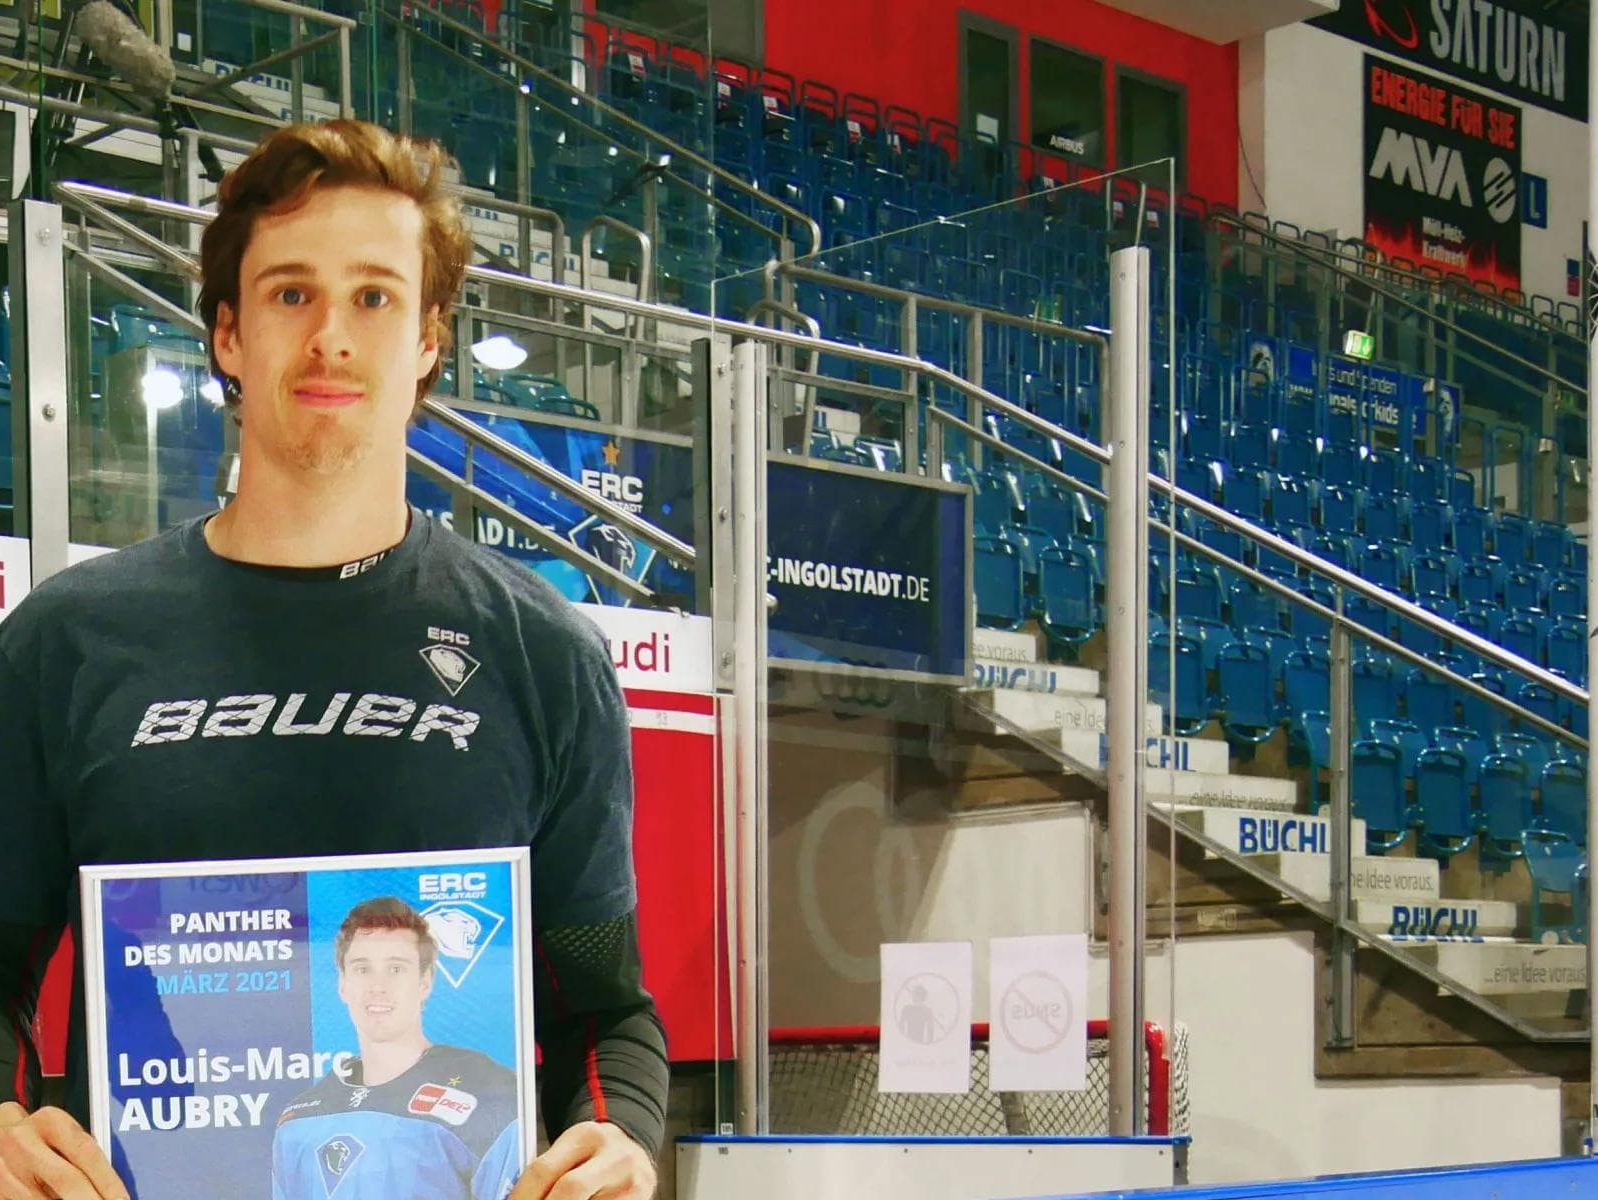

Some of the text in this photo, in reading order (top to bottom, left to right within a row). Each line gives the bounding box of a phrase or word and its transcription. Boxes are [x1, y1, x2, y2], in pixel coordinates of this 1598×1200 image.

[1429, 0, 1565, 101] SATURN
[581, 468, 644, 503] ERC
[427, 626, 471, 647] ERC
[606, 631, 670, 673] udi
[419, 872, 487, 893] ERC
[170, 909, 292, 933] PANTHER
[124, 939, 293, 967] DES MONATS
[157, 968, 292, 996] MÄRZ 2021
[118, 1046, 354, 1087] Louis-Marc
[118, 1092, 270, 1132] AUBRY
